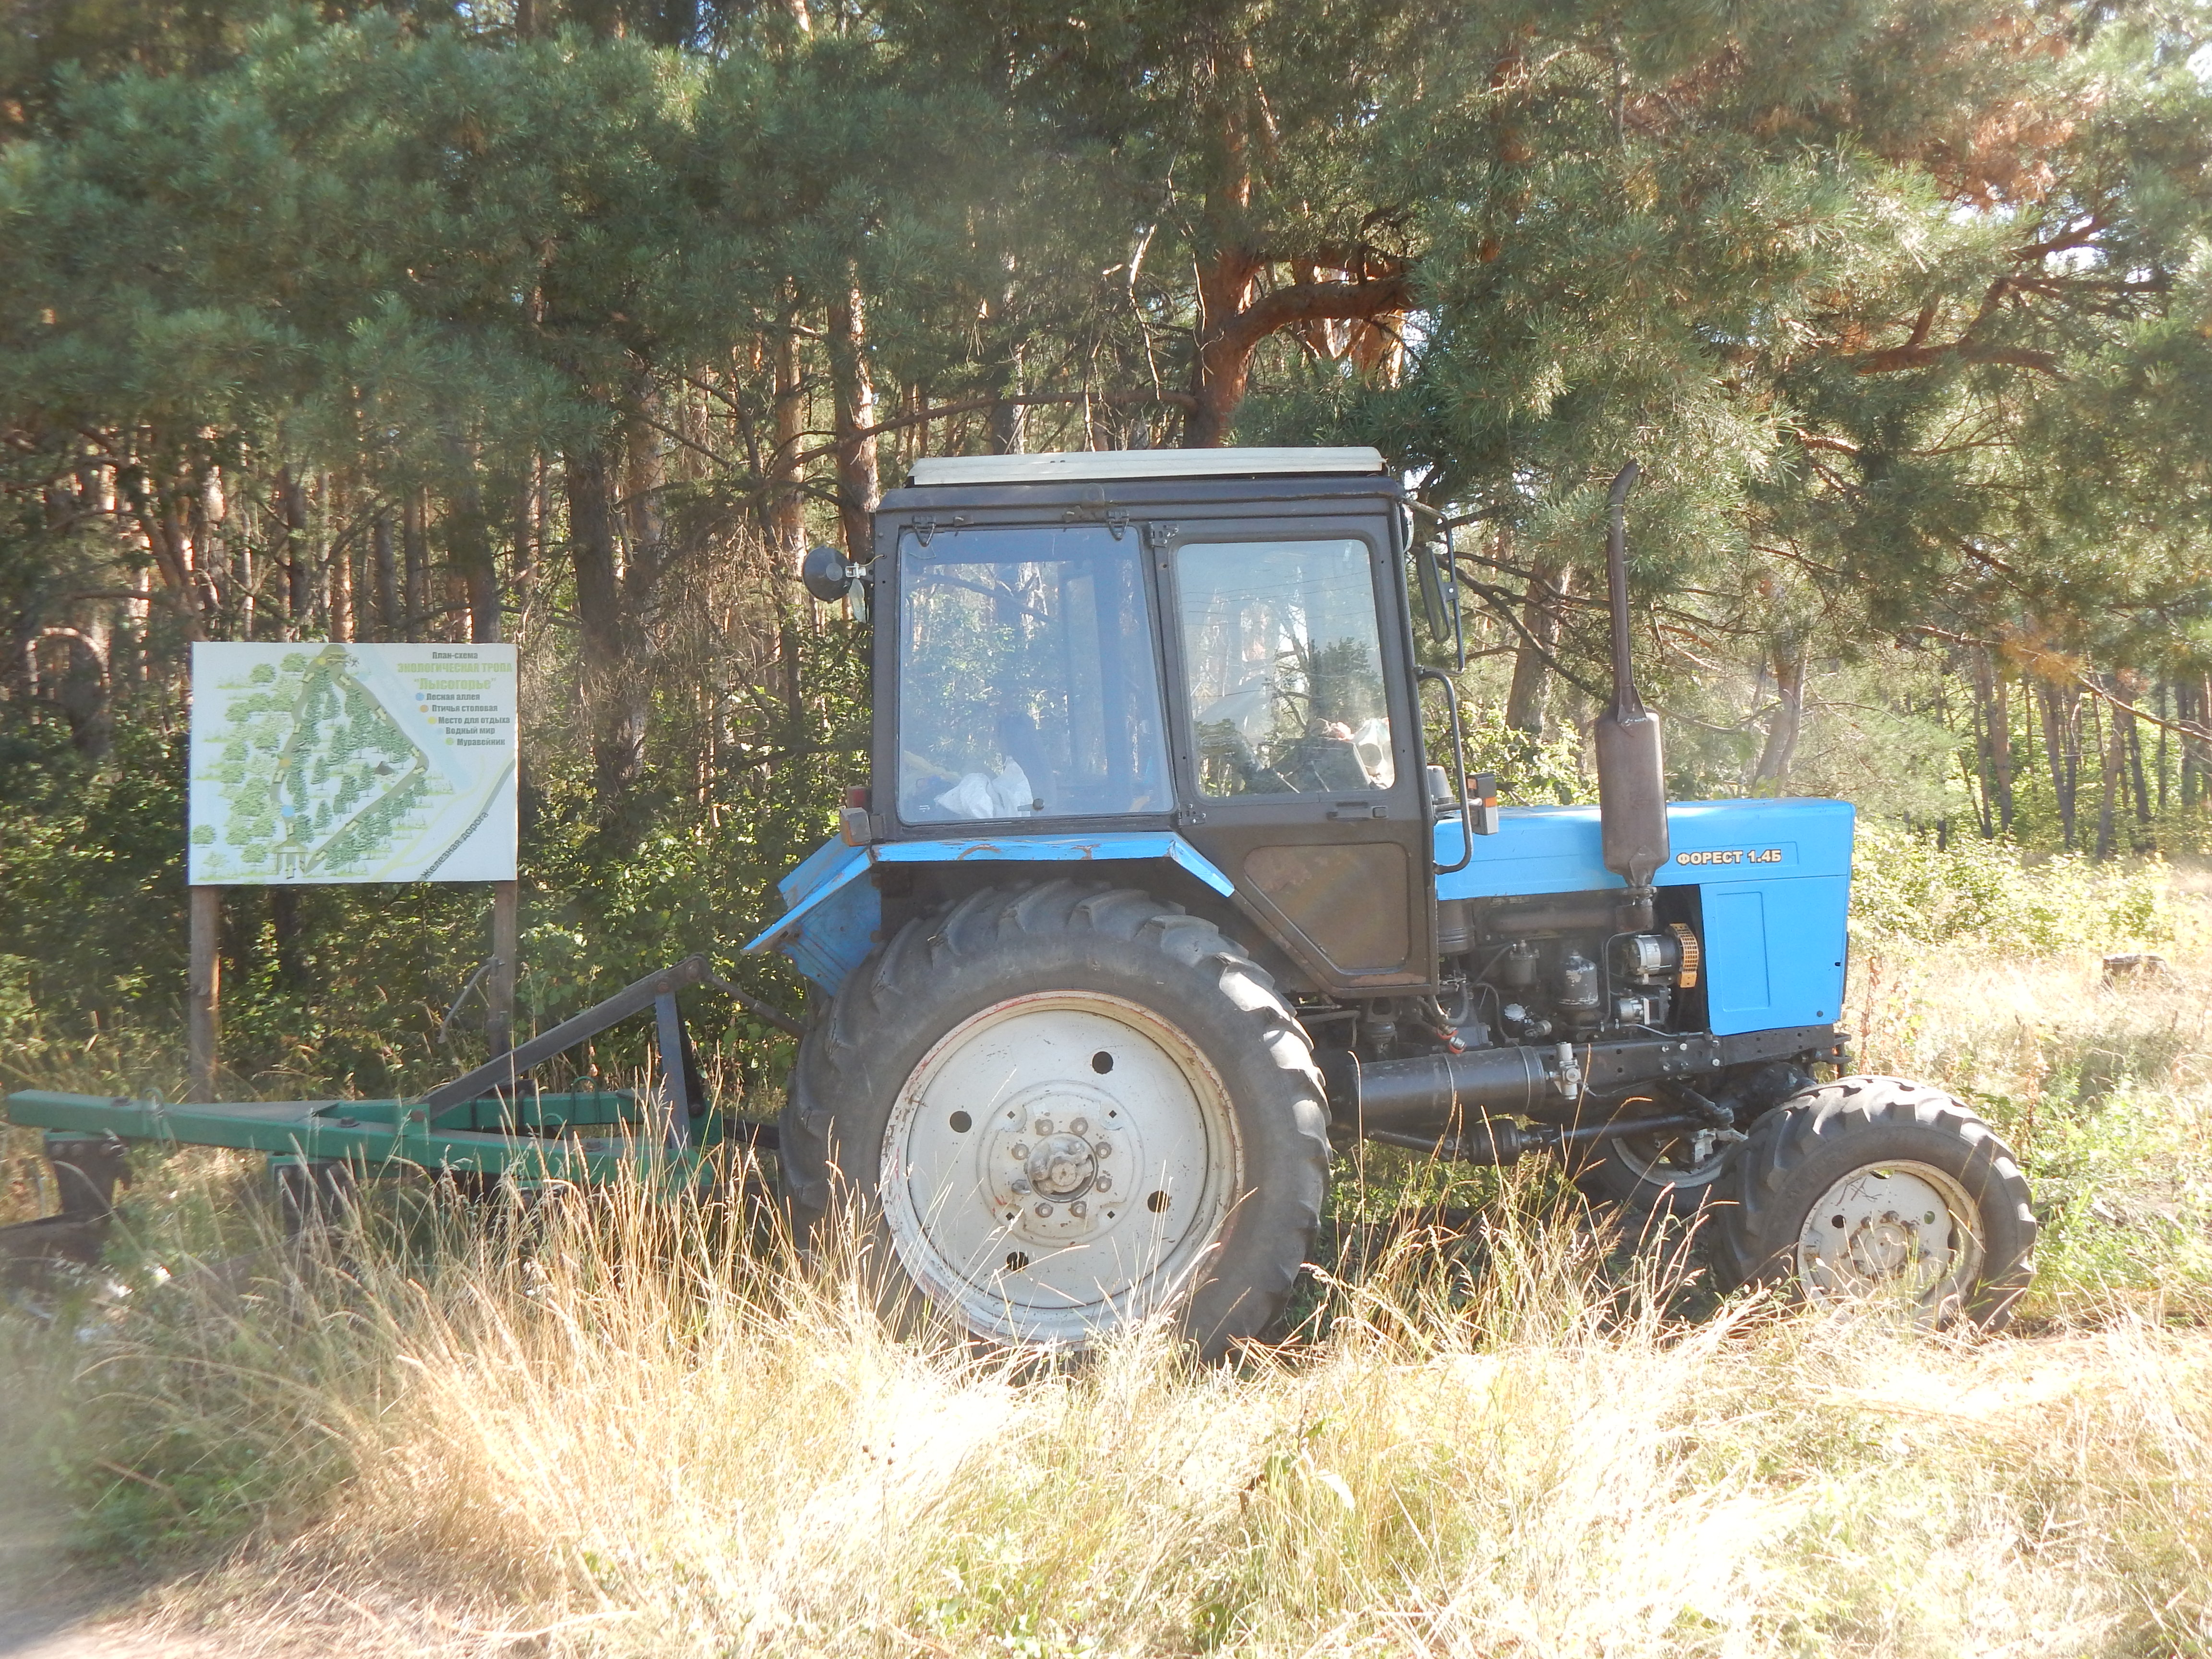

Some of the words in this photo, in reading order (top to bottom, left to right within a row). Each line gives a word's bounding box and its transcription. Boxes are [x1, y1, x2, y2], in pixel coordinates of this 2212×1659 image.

[397, 663, 479, 673] ЭКОЛОГИЧЕСКАЯ
[481, 663, 513, 672] ТРОПА
[446, 726, 478, 734] Водный
[457, 738, 505, 746] Муравейник
[420, 840, 462, 879] Железная
[460, 812, 489, 841] дорога
[1676, 851, 1743, 866] ФОРЕСТ
[1747, 849, 1782, 864] 1.4Б
